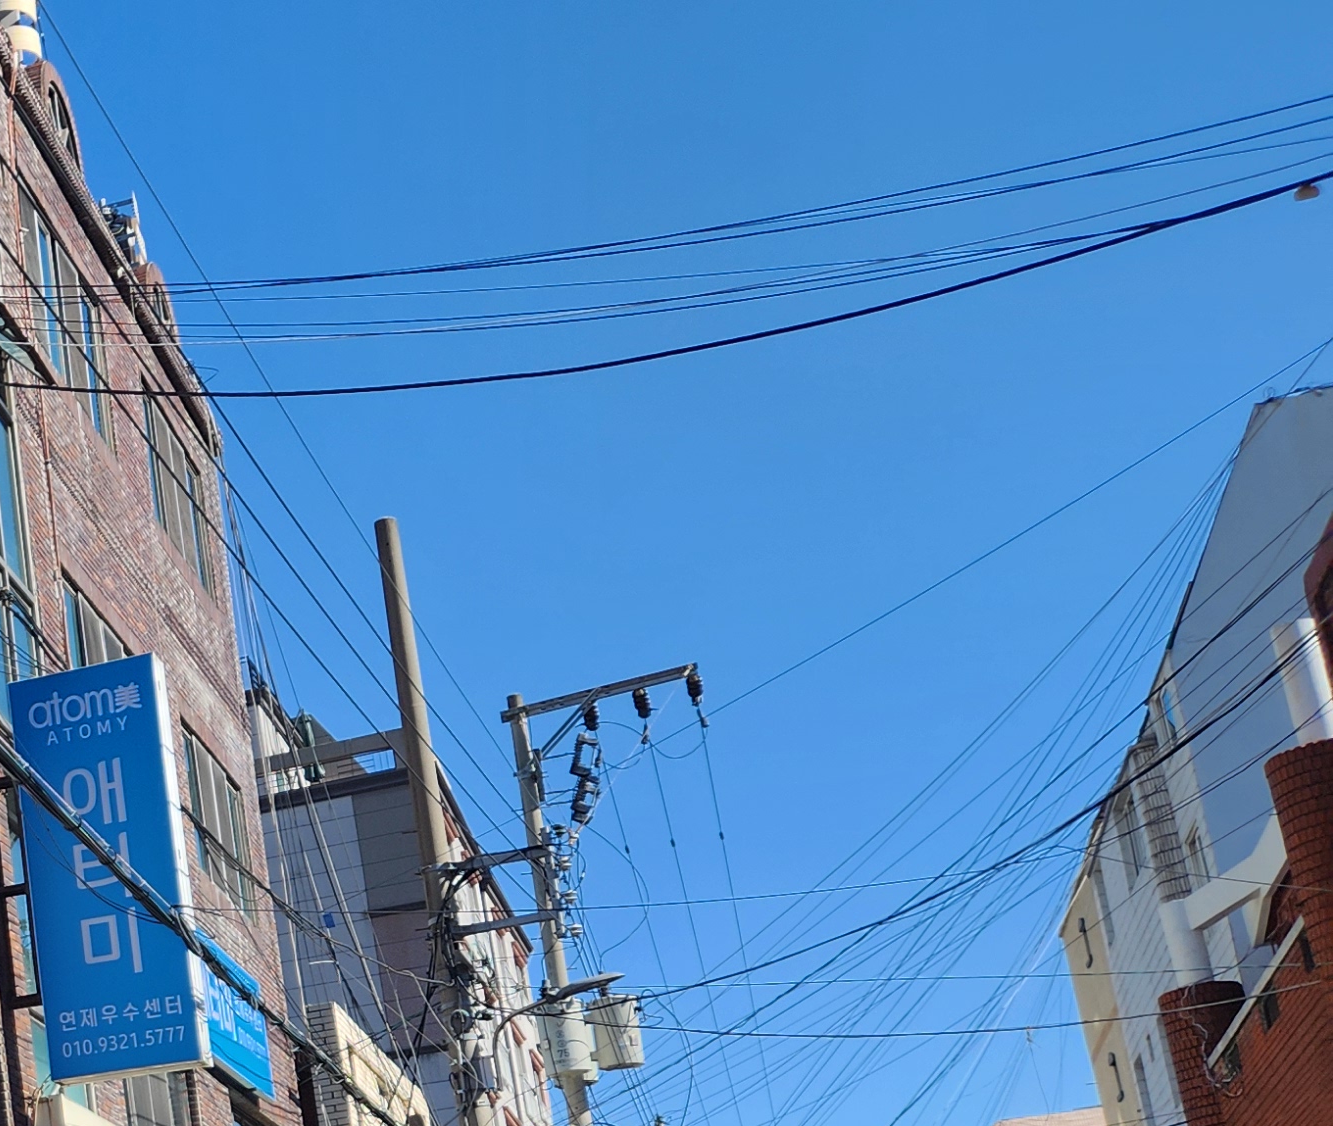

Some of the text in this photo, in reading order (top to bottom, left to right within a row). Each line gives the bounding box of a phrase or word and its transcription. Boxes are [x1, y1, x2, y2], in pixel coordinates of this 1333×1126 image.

[47, 716, 128, 746] ATOMY
[62, 757, 144, 974] 애터미
[58, 994, 184, 1032] 연제우수센터
[62, 1025, 186, 1060] 010.9321.5777
